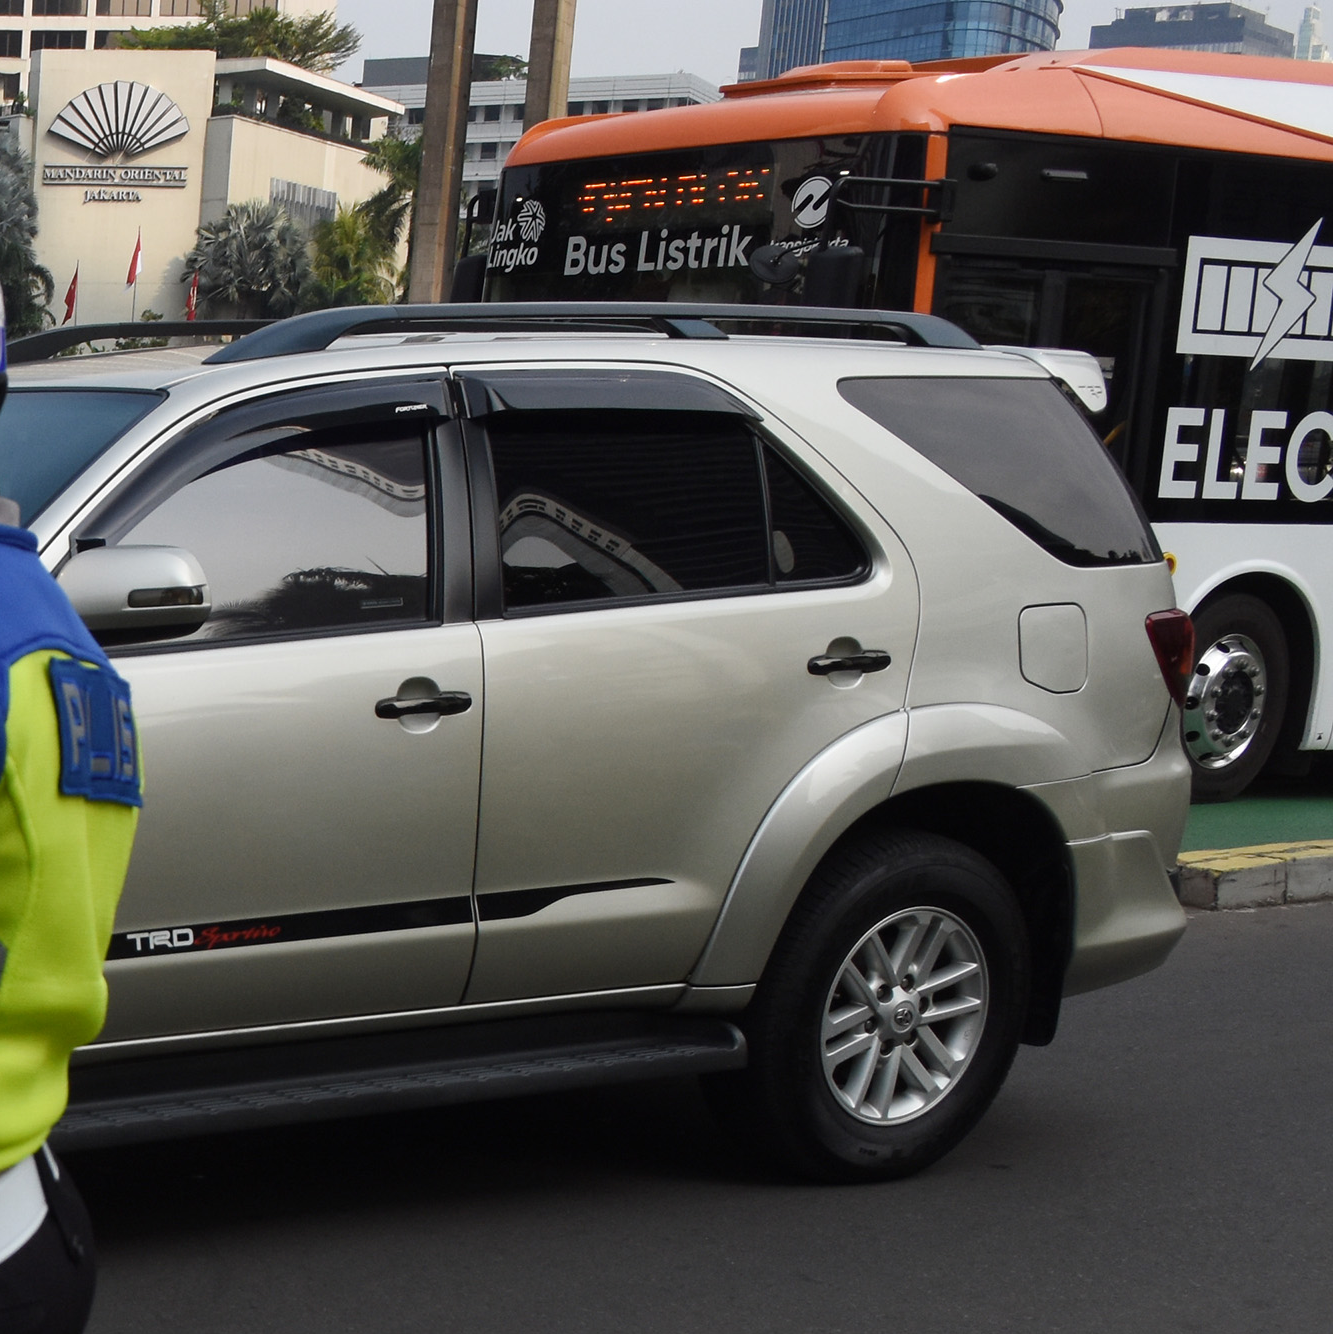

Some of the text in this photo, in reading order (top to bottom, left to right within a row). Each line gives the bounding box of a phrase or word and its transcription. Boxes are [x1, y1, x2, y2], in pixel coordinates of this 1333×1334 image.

[43, 167, 188, 183] MANDARIN ORIENTAL
[84, 188, 142, 203] JAKARTA
[487, 245, 538, 273] Lingko
[564, 224, 753, 276] Bus Listrik
[1158, 407, 1333, 502] ELEC
[126, 927, 195, 951] TRD
